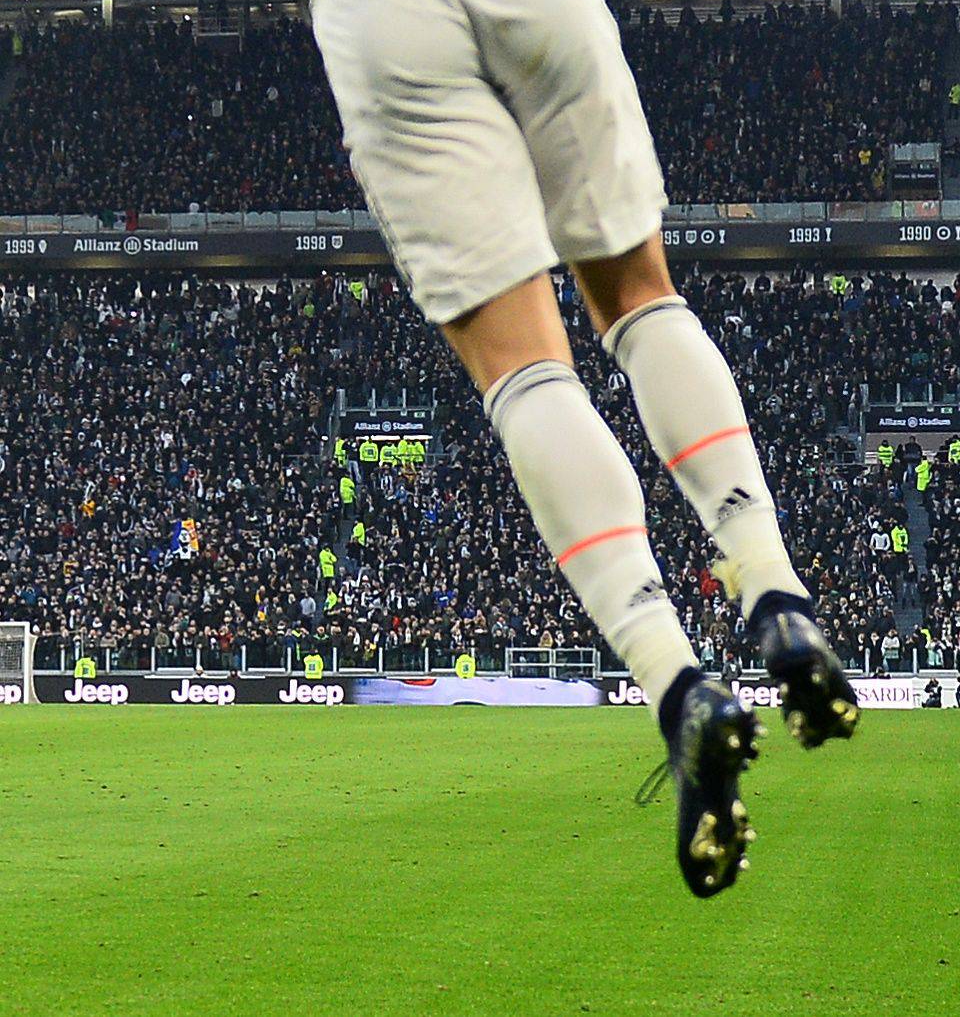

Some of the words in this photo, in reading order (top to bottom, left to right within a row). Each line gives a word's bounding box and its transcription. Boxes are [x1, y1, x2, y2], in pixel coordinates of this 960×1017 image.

[789, 228, 821, 243] 1993
[899, 226, 932, 241] 1990
[5, 239, 35, 254] 1999
[73, 238, 121, 252] Allianz
[143, 238, 199, 251] Stadium
[295, 235, 327, 250] 1998
[354, 422, 381, 431] Allianz
[392, 422, 424, 431] Stadium
[879, 417, 907, 426] Allianz
[919, 417, 952, 426] Stadium
[64, 678, 129, 706] Jeep
[171, 678, 236, 706] Jeep
[279, 678, 345, 706] Jeep
[608, 680, 650, 705] Je
